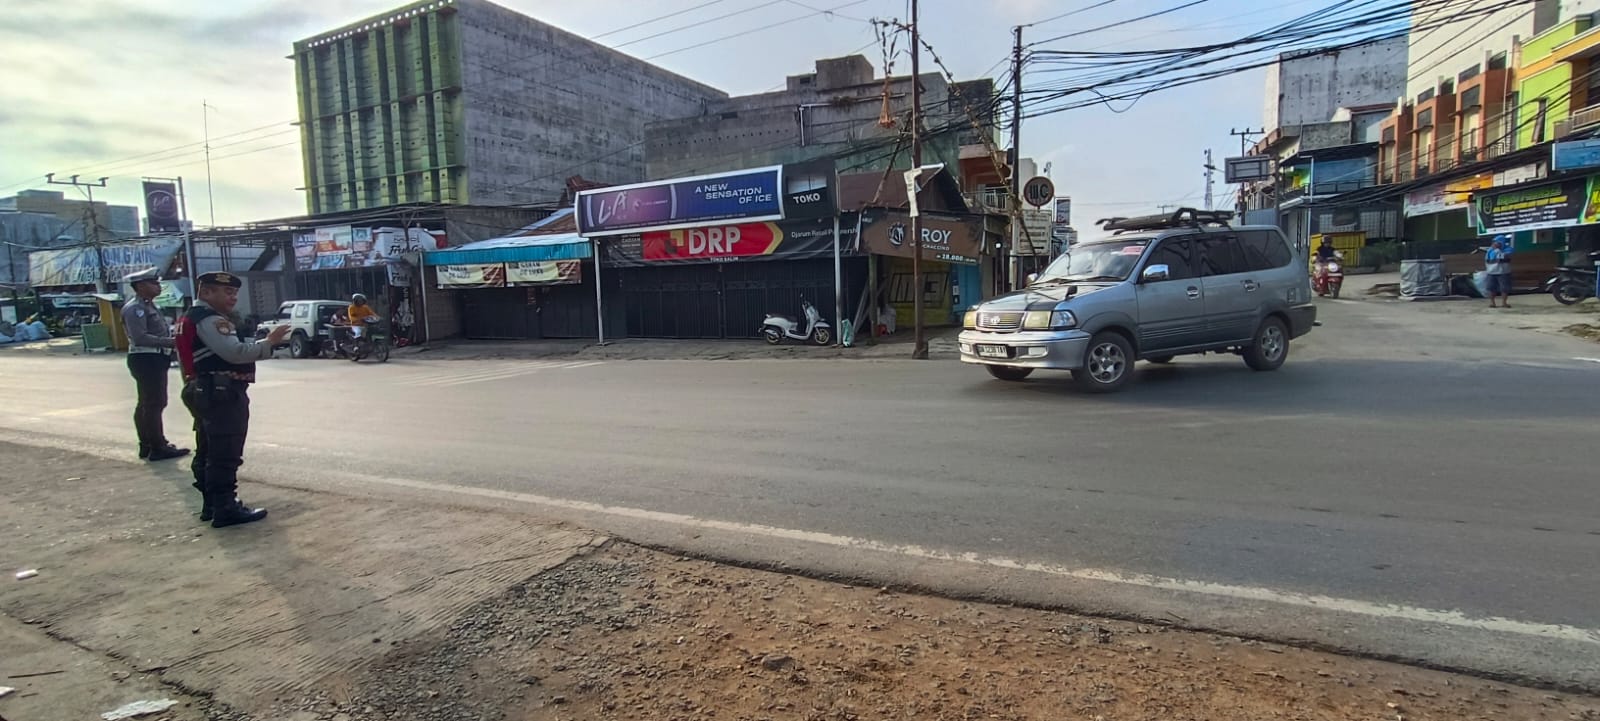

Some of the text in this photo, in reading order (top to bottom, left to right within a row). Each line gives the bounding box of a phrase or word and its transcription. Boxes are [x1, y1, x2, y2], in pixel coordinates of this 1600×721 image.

[704, 183, 729, 192] NEW
[705, 187, 762, 200] SENSATION
[755, 194, 772, 202] ICE
[793, 192, 821, 204] TOKO
[689, 226, 741, 254] DRP
